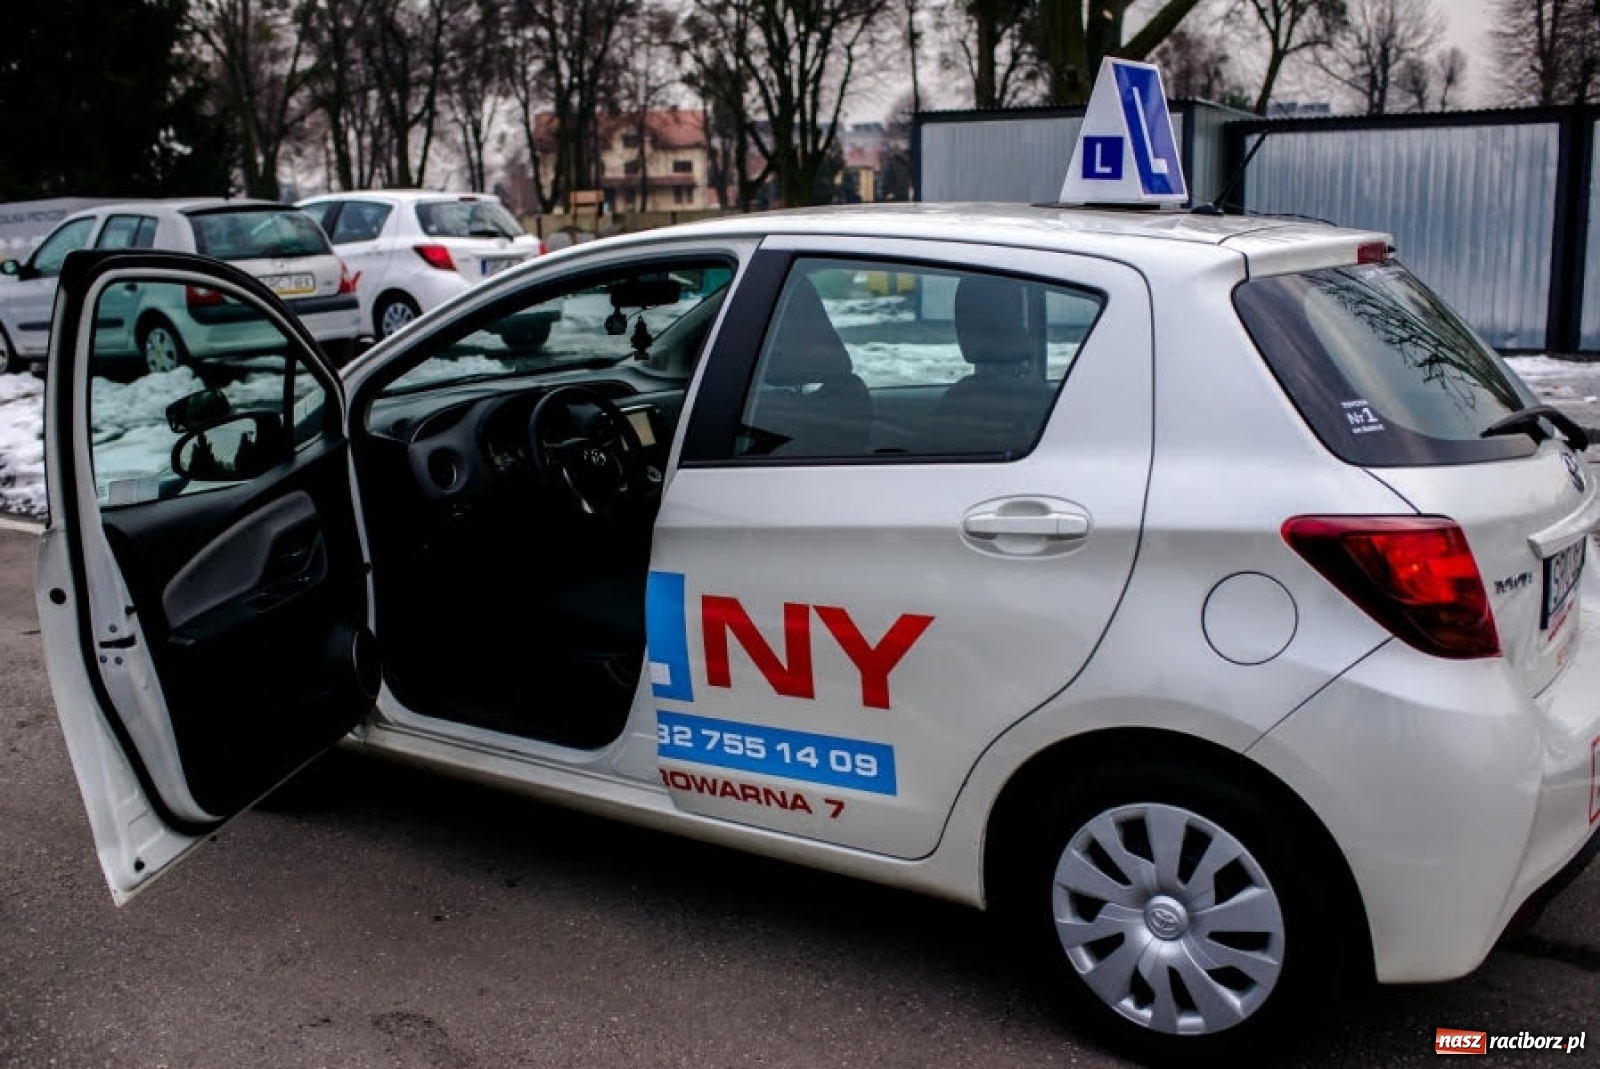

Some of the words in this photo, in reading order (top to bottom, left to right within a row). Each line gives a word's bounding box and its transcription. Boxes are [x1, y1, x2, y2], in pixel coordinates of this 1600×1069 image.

[1132, 86, 1169, 174] L
[1093, 142, 1113, 174] L
[701, 594, 935, 710] NY
[701, 728, 767, 760] 755
[776, 742, 819, 769] 14
[829, 748, 878, 777] 09
[823, 797, 845, 819] 7
